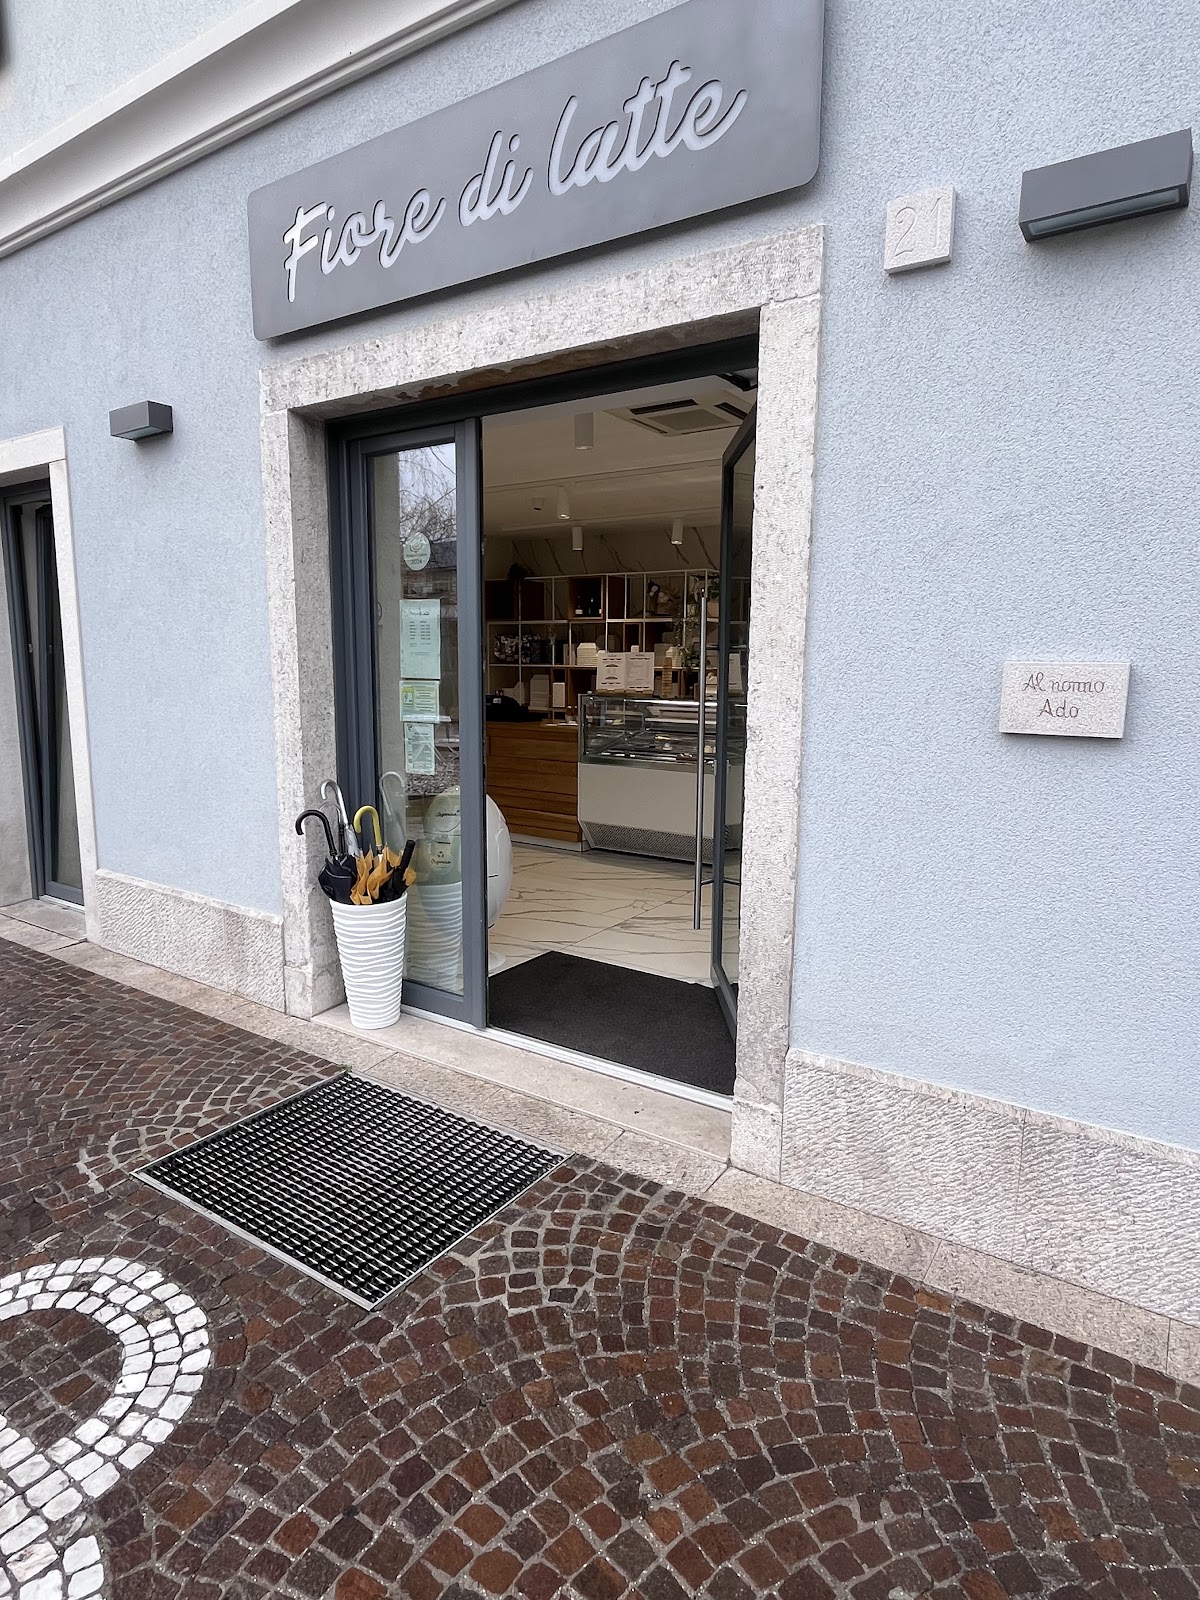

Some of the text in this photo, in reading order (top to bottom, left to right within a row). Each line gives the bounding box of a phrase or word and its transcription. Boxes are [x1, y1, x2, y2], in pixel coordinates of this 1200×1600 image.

[283, 188, 447, 303] Fiore
[458, 130, 534, 227] di
[894, 196, 943, 257] 21
[1021, 671, 1046, 692] Al
[1037, 698, 1079, 718] Ado
